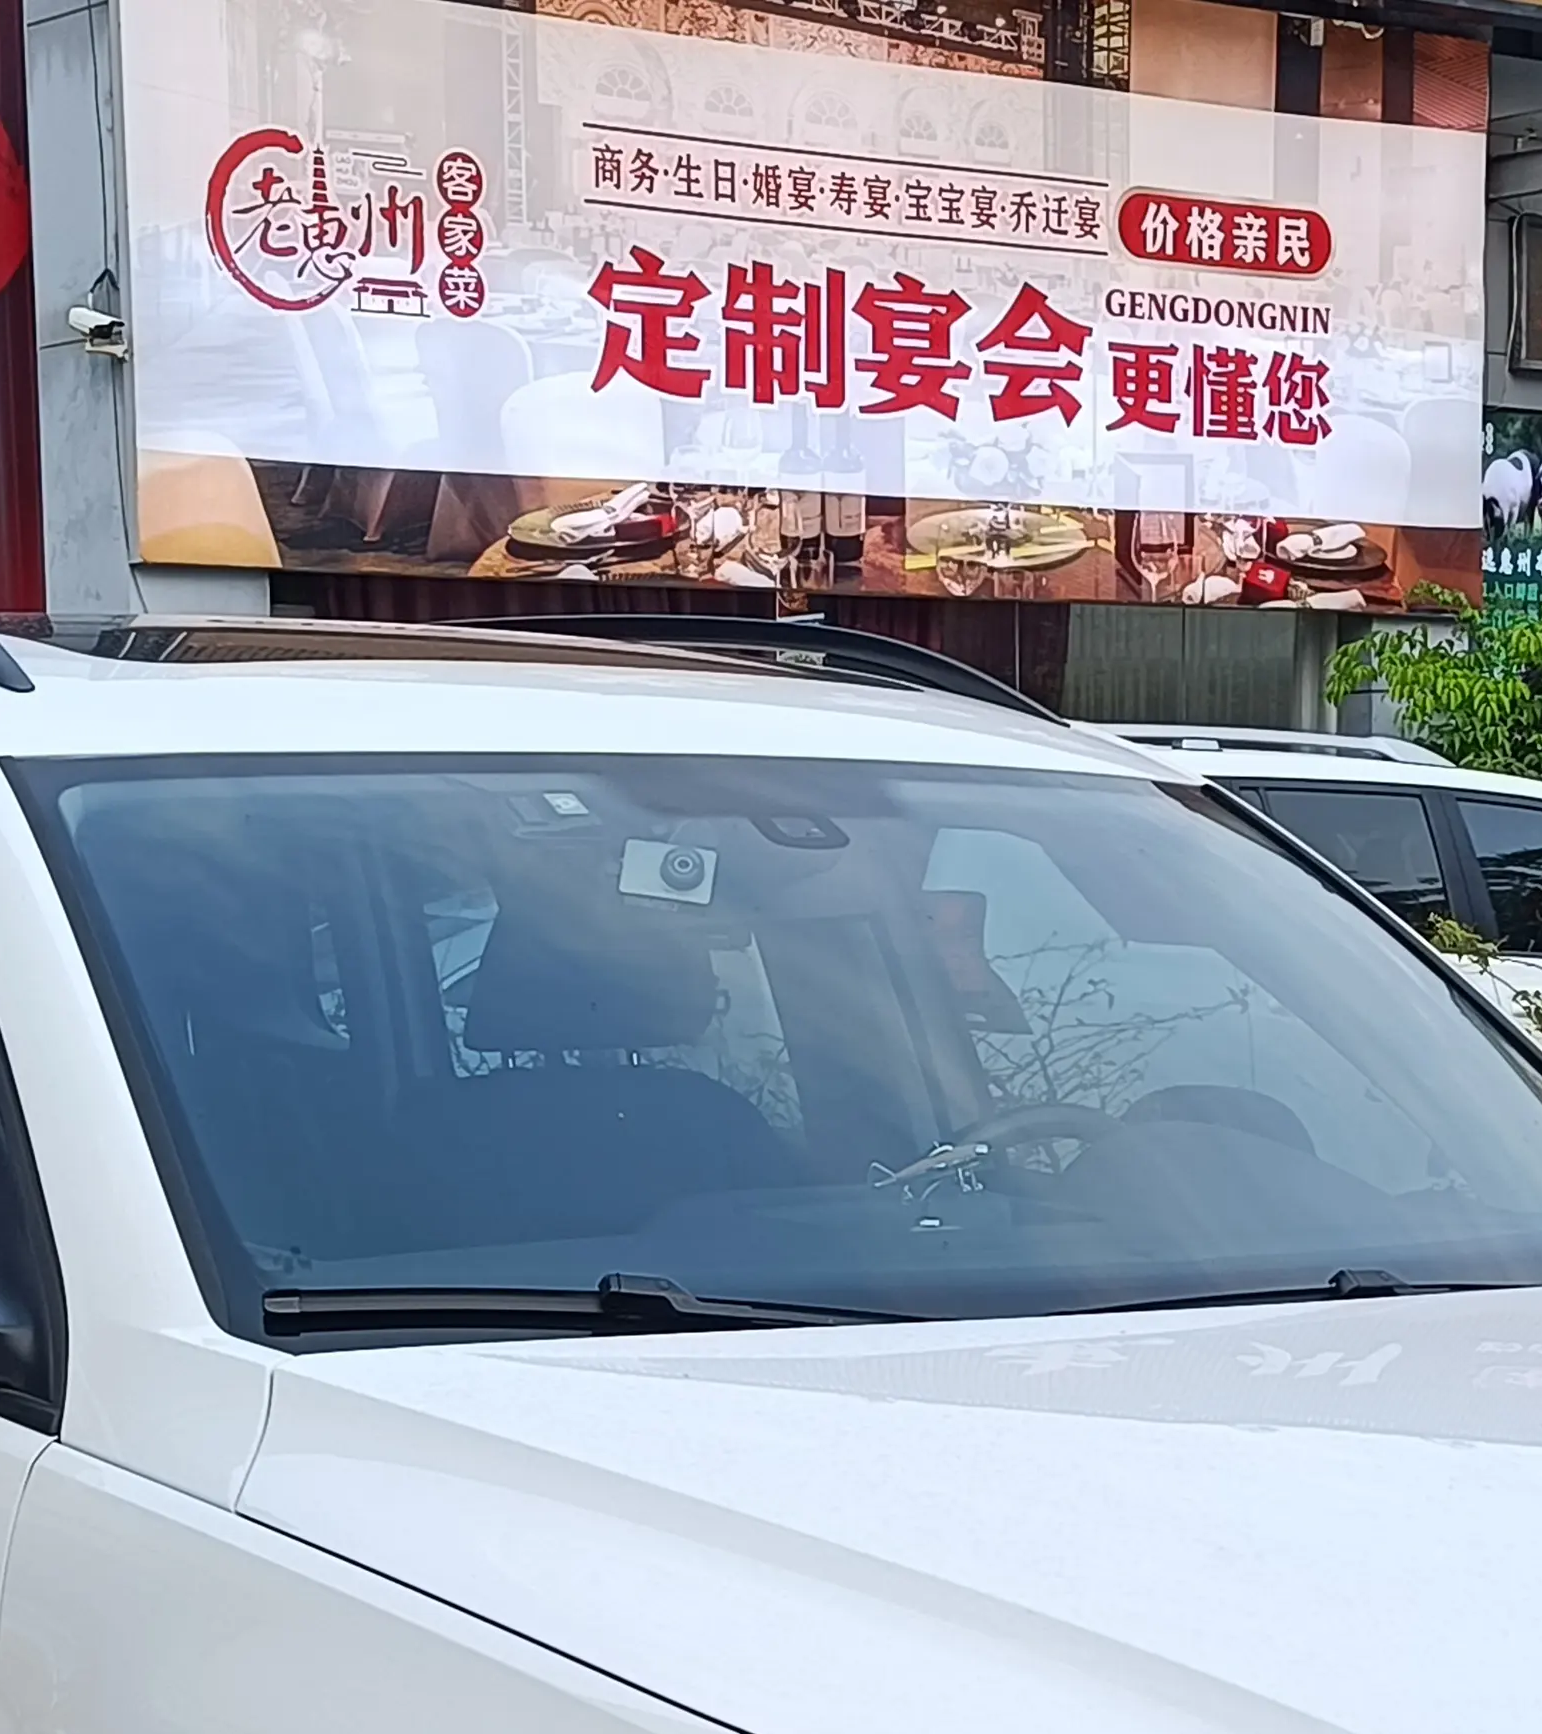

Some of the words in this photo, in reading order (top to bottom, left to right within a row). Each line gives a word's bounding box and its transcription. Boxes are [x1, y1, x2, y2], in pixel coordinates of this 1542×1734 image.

[440, 156, 481, 312] 客家菜
[1139, 203, 1313, 268] 价格亲民
[587, 246, 1094, 427] 定制宴会
[1106, 340, 1333, 447] 更懂您
[1105, 288, 1332, 334] GENGDONGNIN
